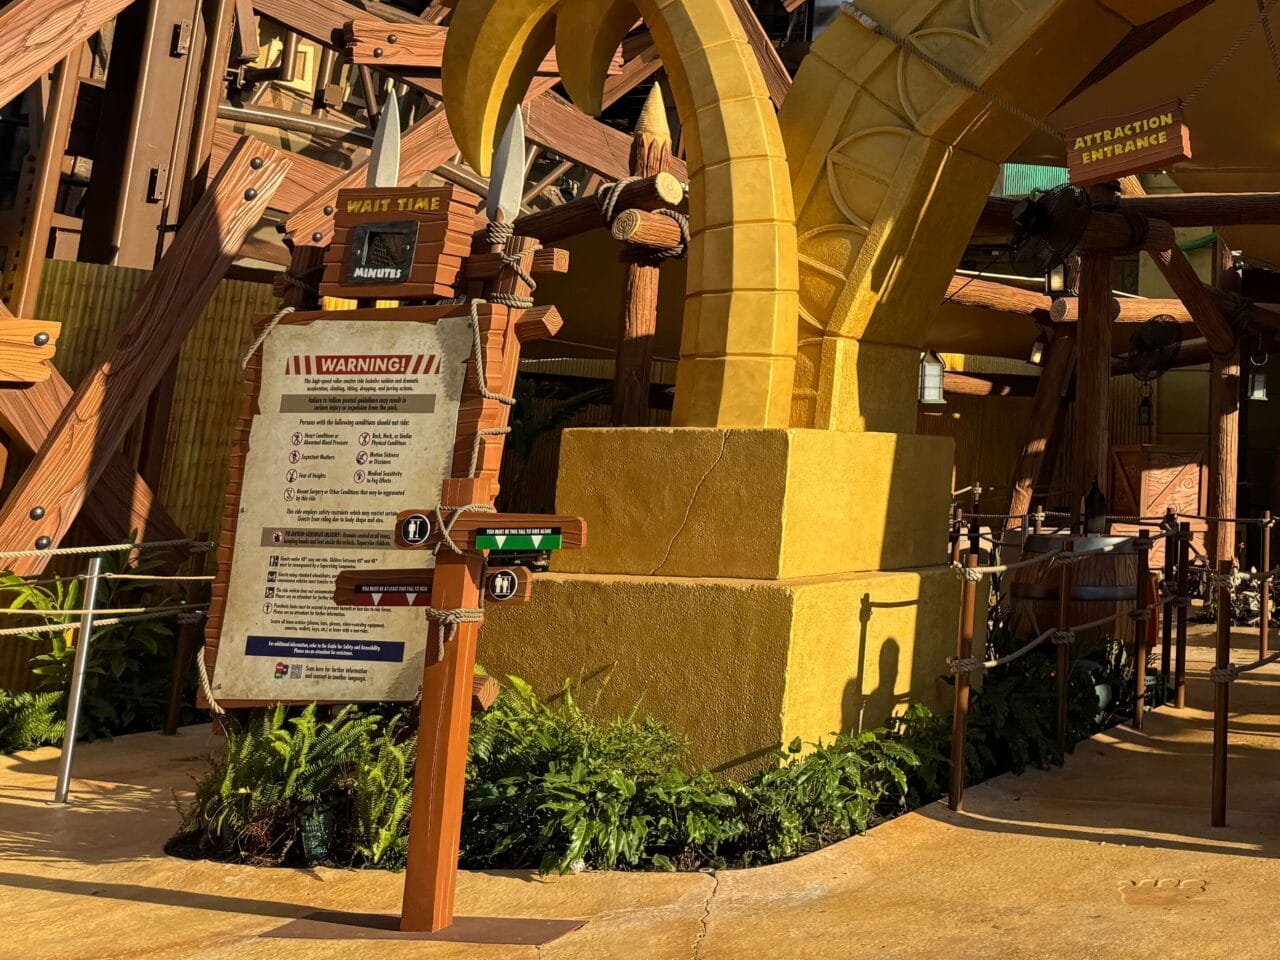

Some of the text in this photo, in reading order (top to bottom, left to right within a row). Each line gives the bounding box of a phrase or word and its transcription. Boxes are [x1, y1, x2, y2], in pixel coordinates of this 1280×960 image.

[1074, 113, 1173, 150] ATTRACTION
[1082, 132, 1168, 164] ENTRANCE
[347, 197, 441, 213] WAIT TIME
[353, 267, 402, 279] MINUTES
[321, 358, 406, 372] WARNING!
